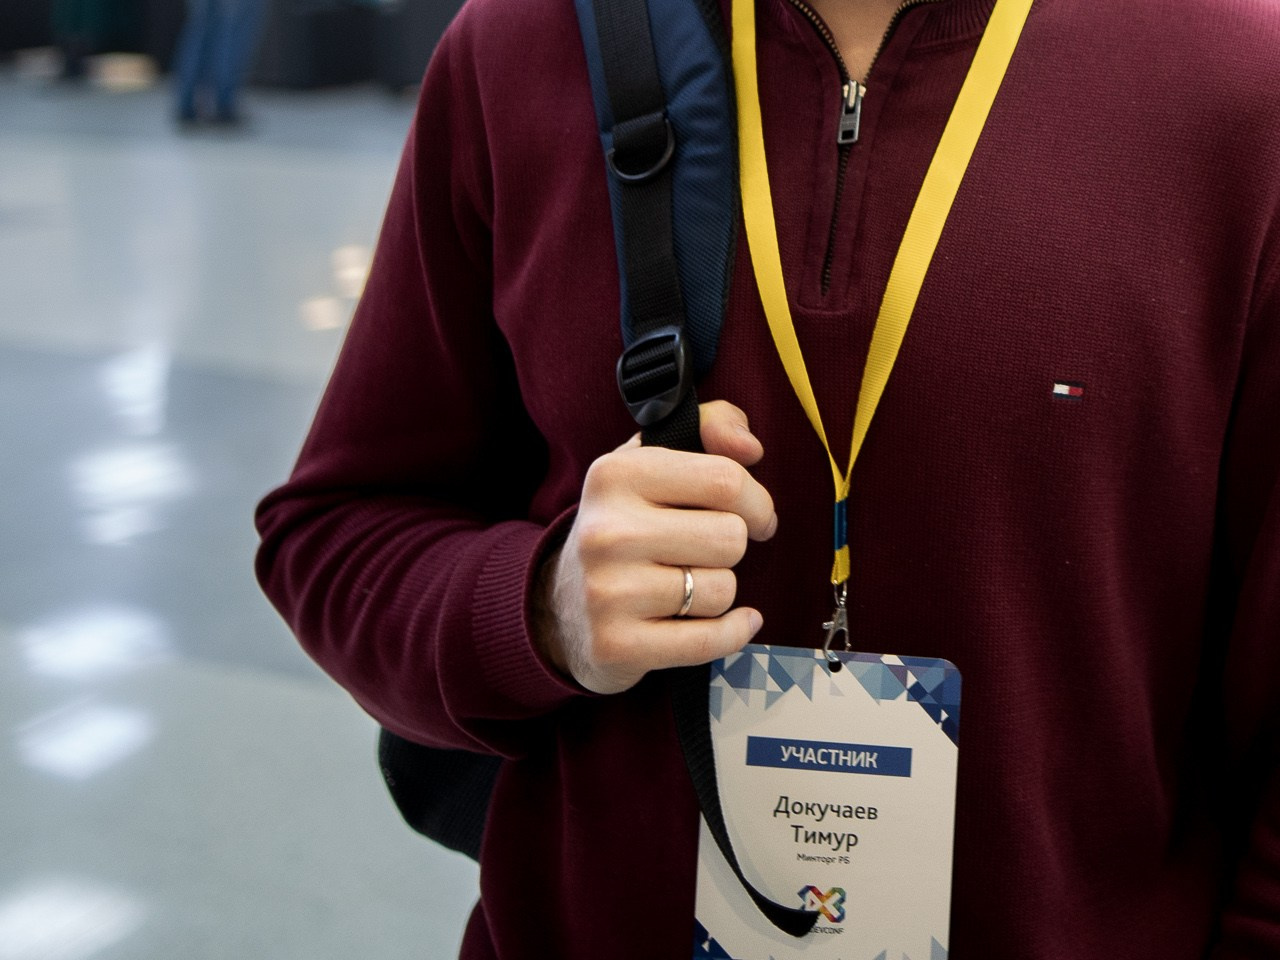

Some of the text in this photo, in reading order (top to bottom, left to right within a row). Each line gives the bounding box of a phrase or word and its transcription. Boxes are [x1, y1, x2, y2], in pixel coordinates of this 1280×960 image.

[780, 745, 878, 769] УЧАСТНИК
[773, 795, 878, 822] Докучаев
[790, 824, 859, 852] Тимур
[797, 853, 836, 865] Минторг
